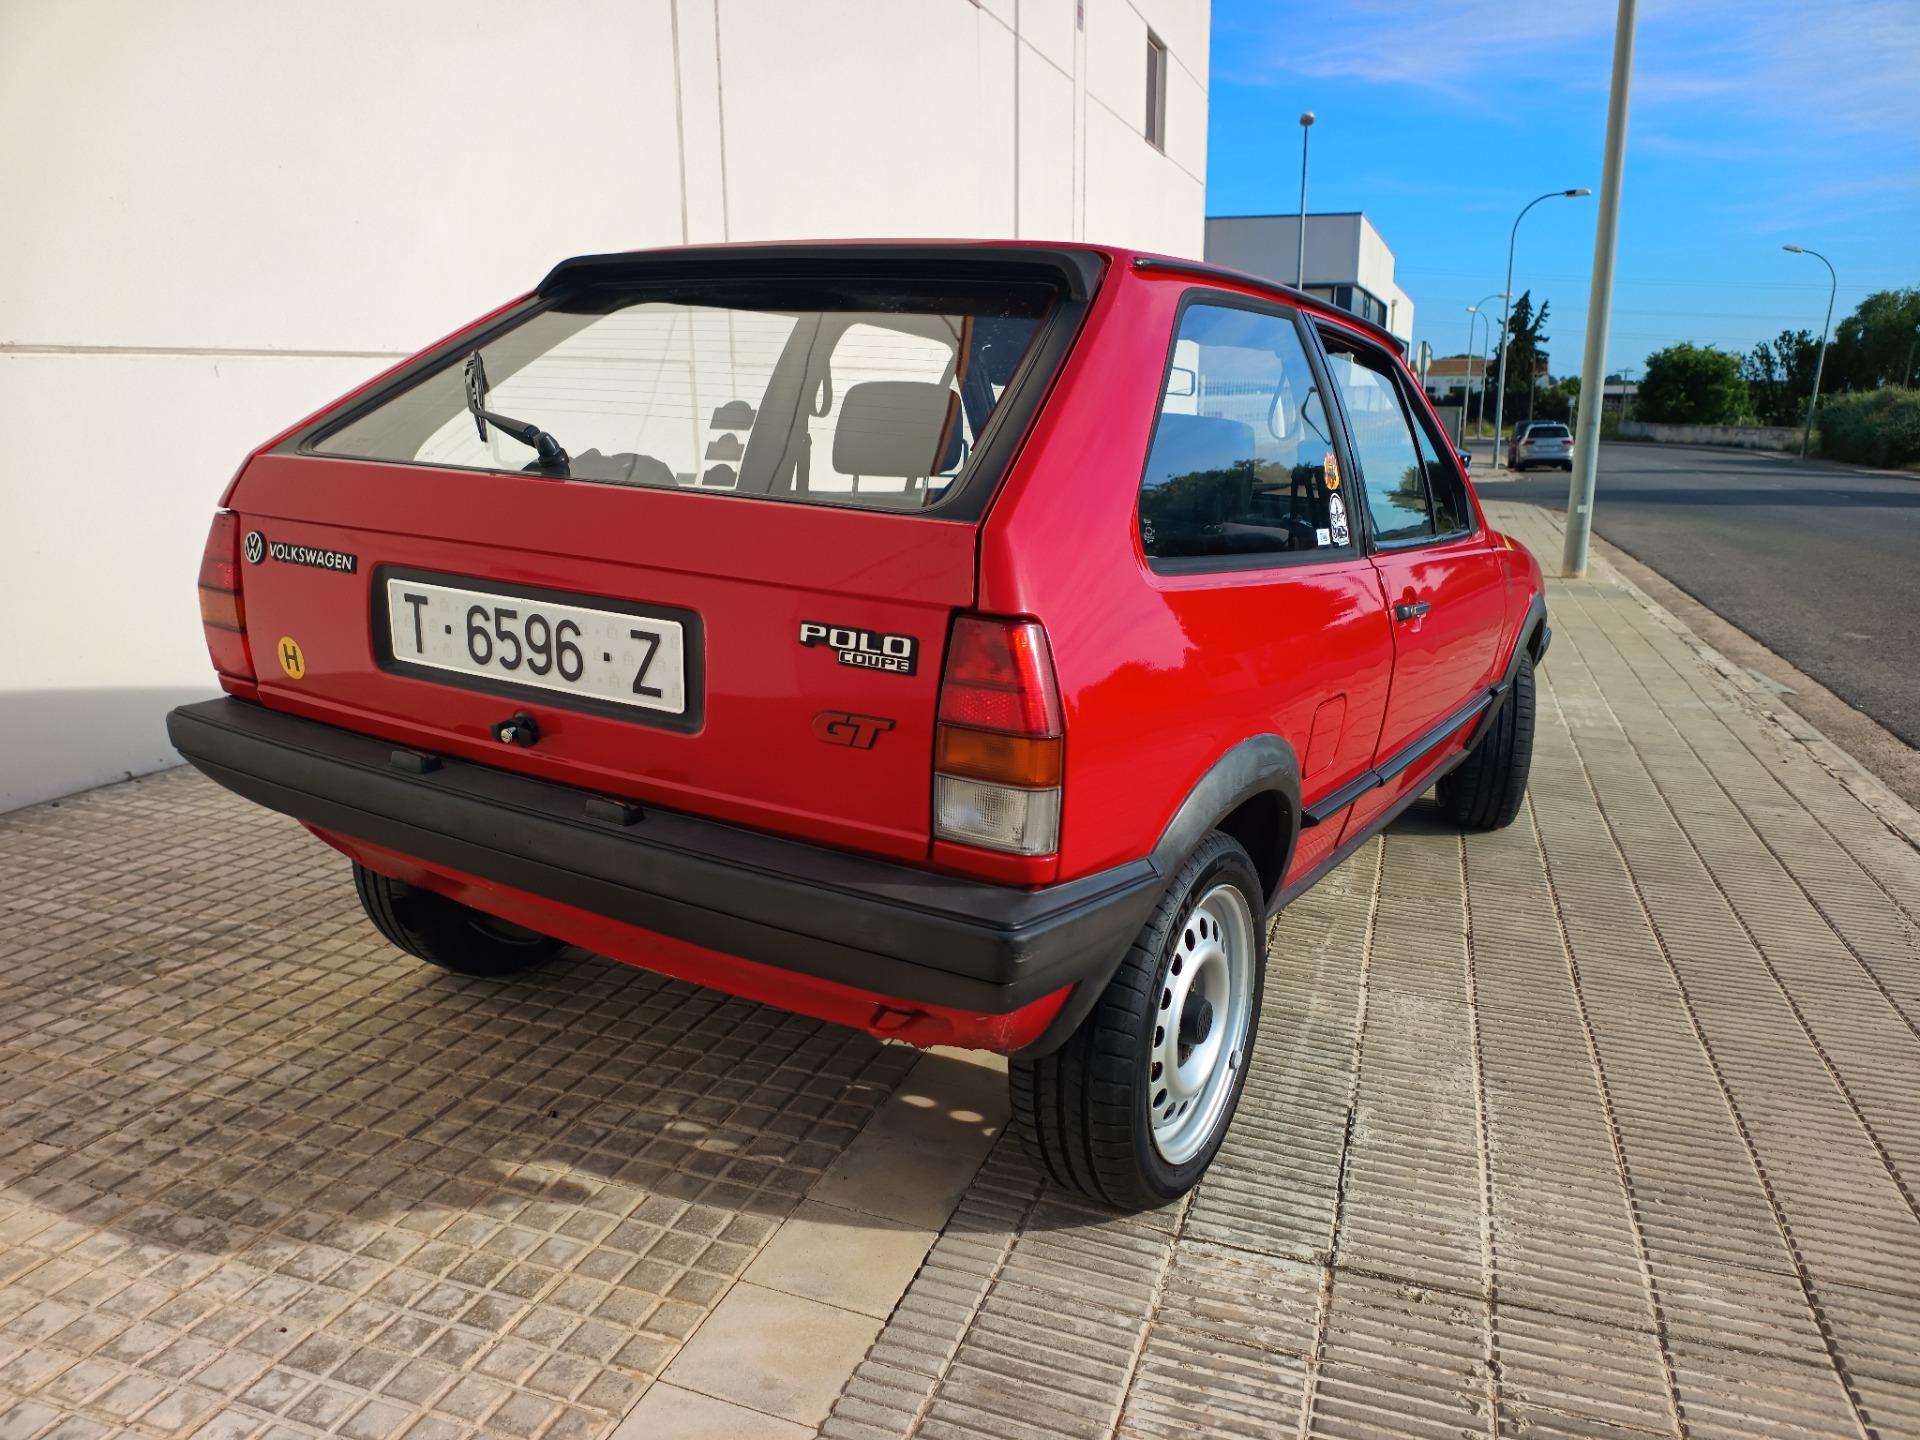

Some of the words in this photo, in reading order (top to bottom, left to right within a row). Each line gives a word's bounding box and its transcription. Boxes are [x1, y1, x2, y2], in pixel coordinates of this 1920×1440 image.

[269, 543, 353, 570] VOLKSWAGEN
[800, 623, 912, 658] POLO
[282, 643, 300, 672] H
[840, 650, 909, 672] COUPE
[812, 709, 897, 751] GT
